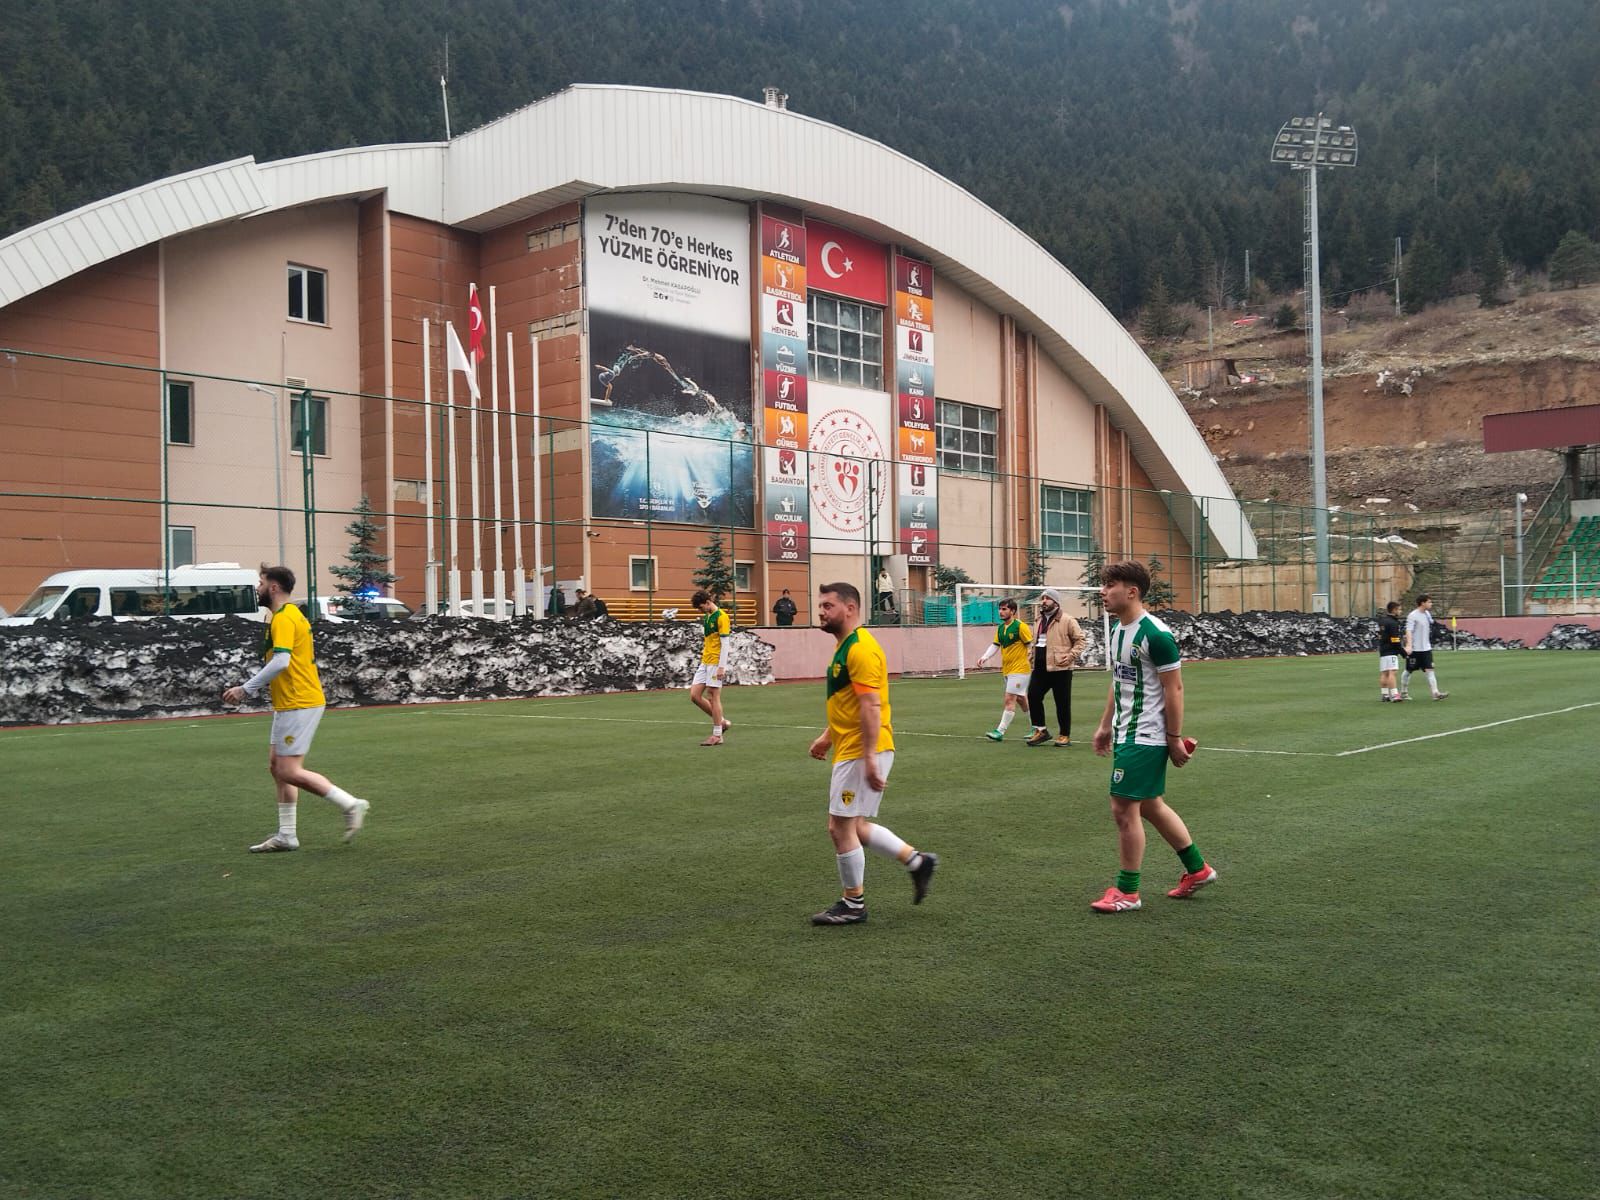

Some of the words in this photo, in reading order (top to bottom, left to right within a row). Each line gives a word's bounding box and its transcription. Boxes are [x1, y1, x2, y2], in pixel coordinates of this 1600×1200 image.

[604, 213, 647, 241] 7'den
[651, 226, 683, 249] 70'e
[687, 235, 734, 262] Herkes
[598, 235, 653, 264] YÜZME
[657, 248, 740, 286] ÖĞRENİYOR
[766, 286, 803, 301] BASKETBOL
[900, 317, 915, 328] MASA
[771, 326, 800, 338] HENTBOL
[775, 362, 797, 375] YÜZME
[909, 387, 925, 396] KANO
[774, 401, 799, 412] FUTBOL
[903, 420, 931, 431] VOLEYBOL
[901, 454, 934, 463] TAEKWONDO
[911, 488, 926, 496] BOKS
